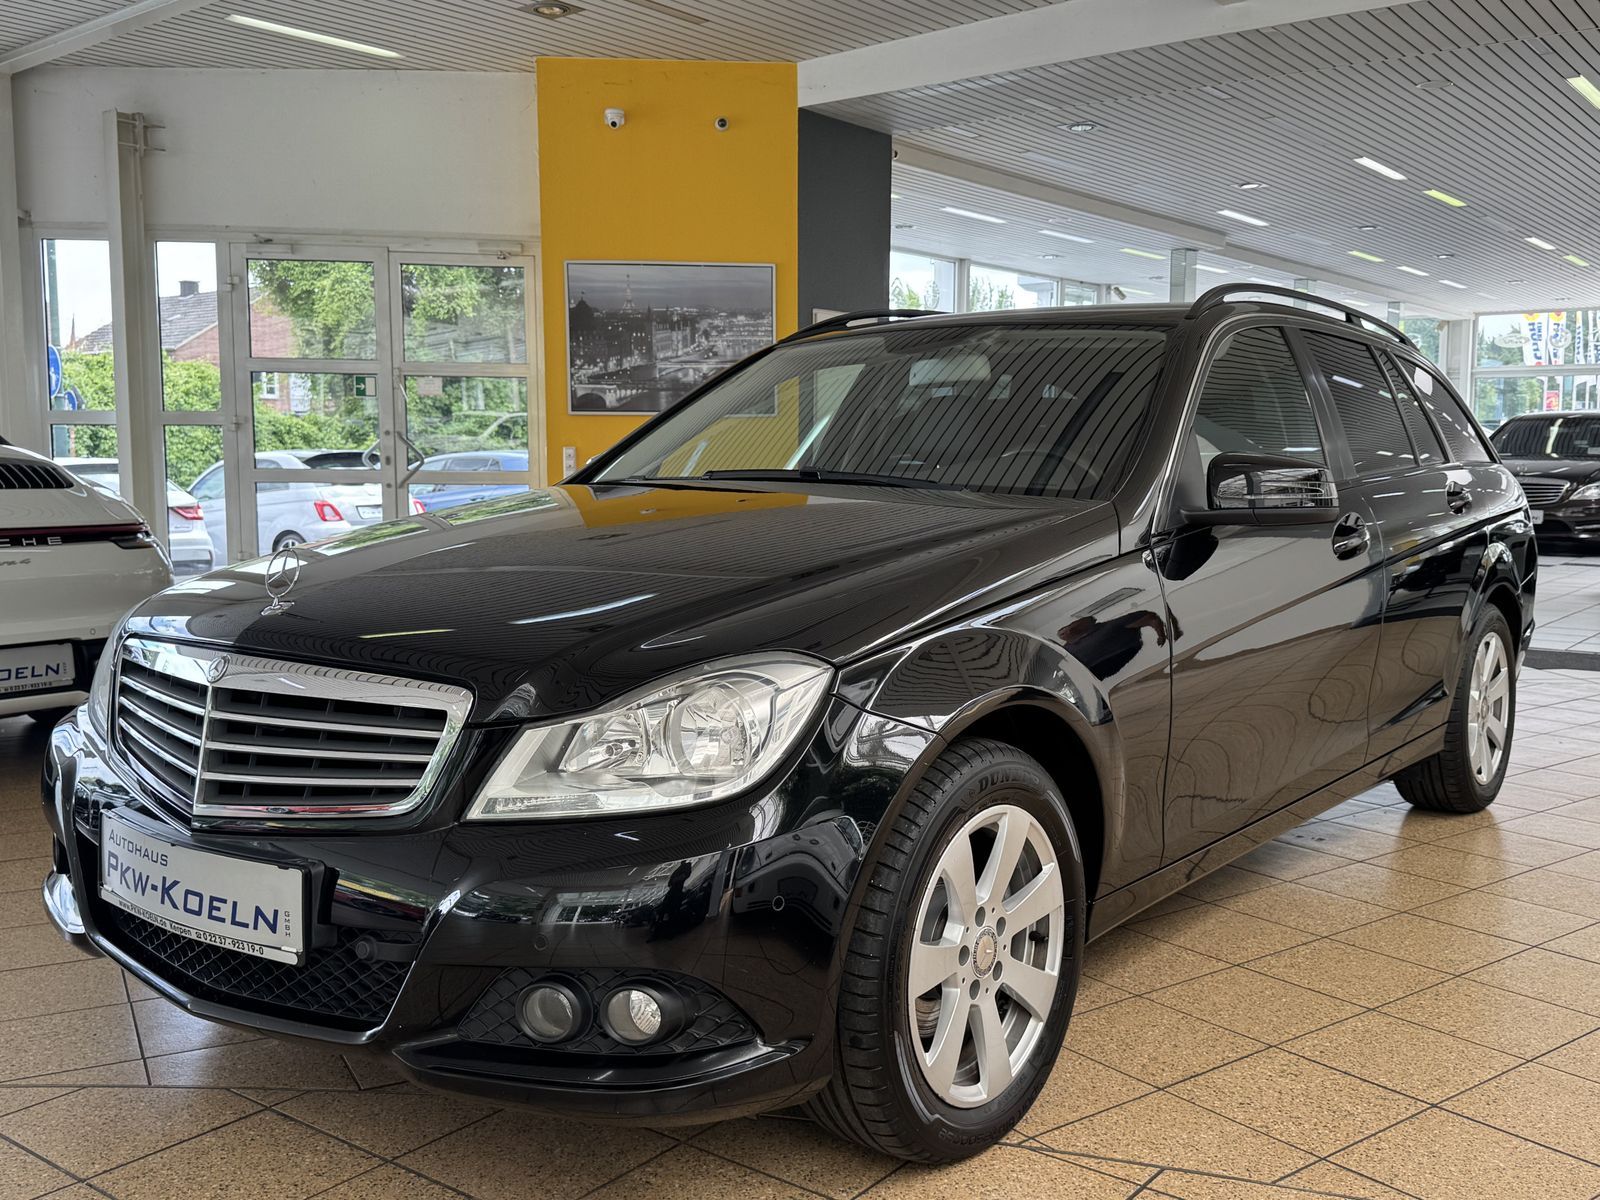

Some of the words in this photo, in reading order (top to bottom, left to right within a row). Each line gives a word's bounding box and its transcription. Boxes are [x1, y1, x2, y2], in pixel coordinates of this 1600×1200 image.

[108, 829, 169, 867] AUTOHAUS
[107, 850, 279, 935] PKW-KOELN
[169, 922, 193, 937] Kerpen
